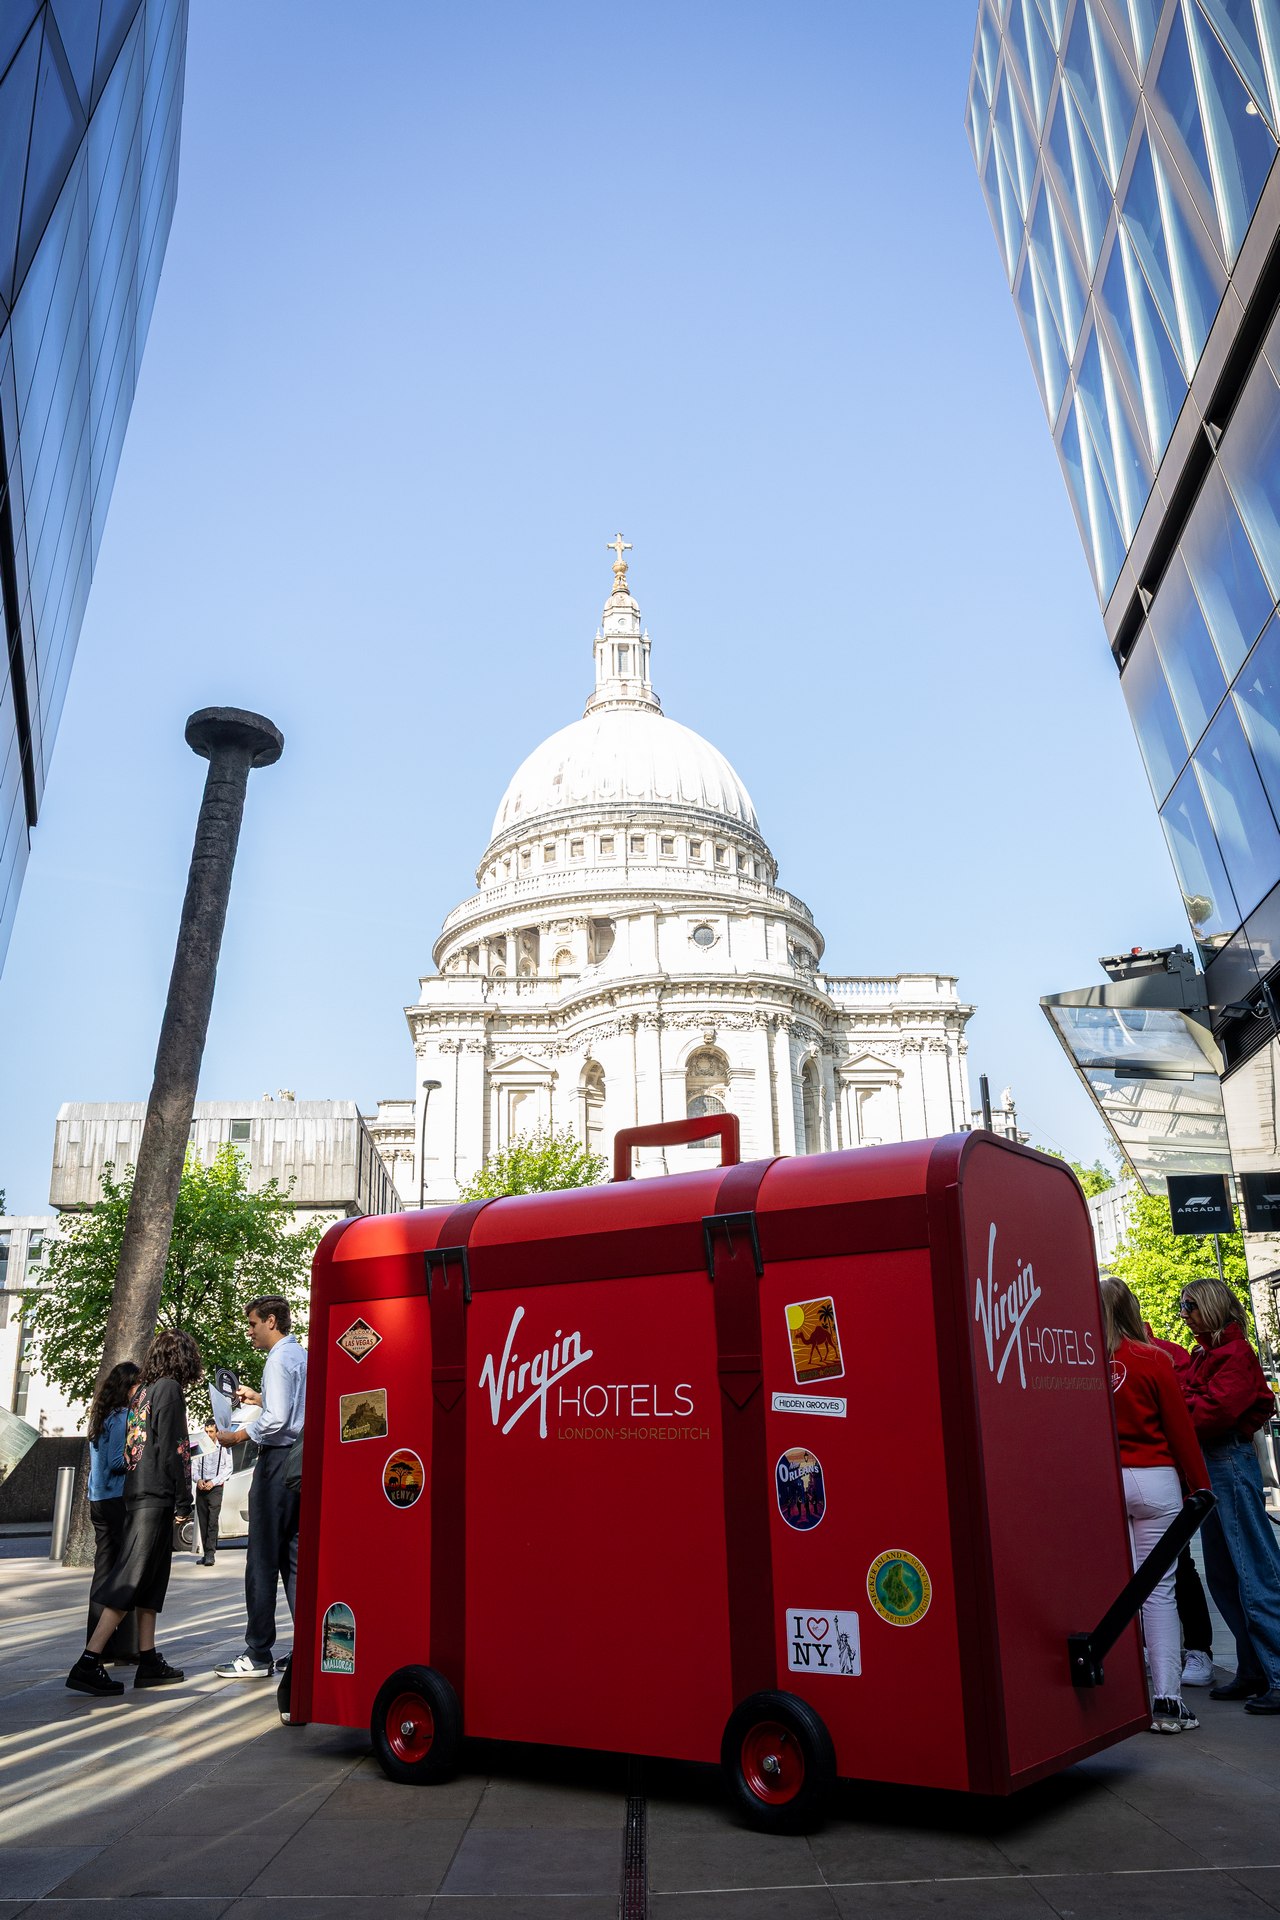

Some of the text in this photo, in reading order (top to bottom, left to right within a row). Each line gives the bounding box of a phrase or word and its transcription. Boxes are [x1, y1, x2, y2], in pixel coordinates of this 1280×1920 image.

[974, 1222, 1042, 1390] Virgin
[356, 1338, 373, 1347] VEGAS
[1026, 1326, 1096, 1366] HOTELS
[478, 1306, 593, 1439] Virgin
[558, 1384, 694, 1417] HOTELS
[779, 1399, 840, 1411] HIDDEN GROOVES
[557, 1427, 710, 1440] LONDON-SHOREDITCH
[391, 1490, 415, 1502] KENYA
[869, 1551, 902, 1606] NECKER ISLAND
[793, 1616, 805, 1639] I
[324, 1659, 352, 1672] MALLORCA
